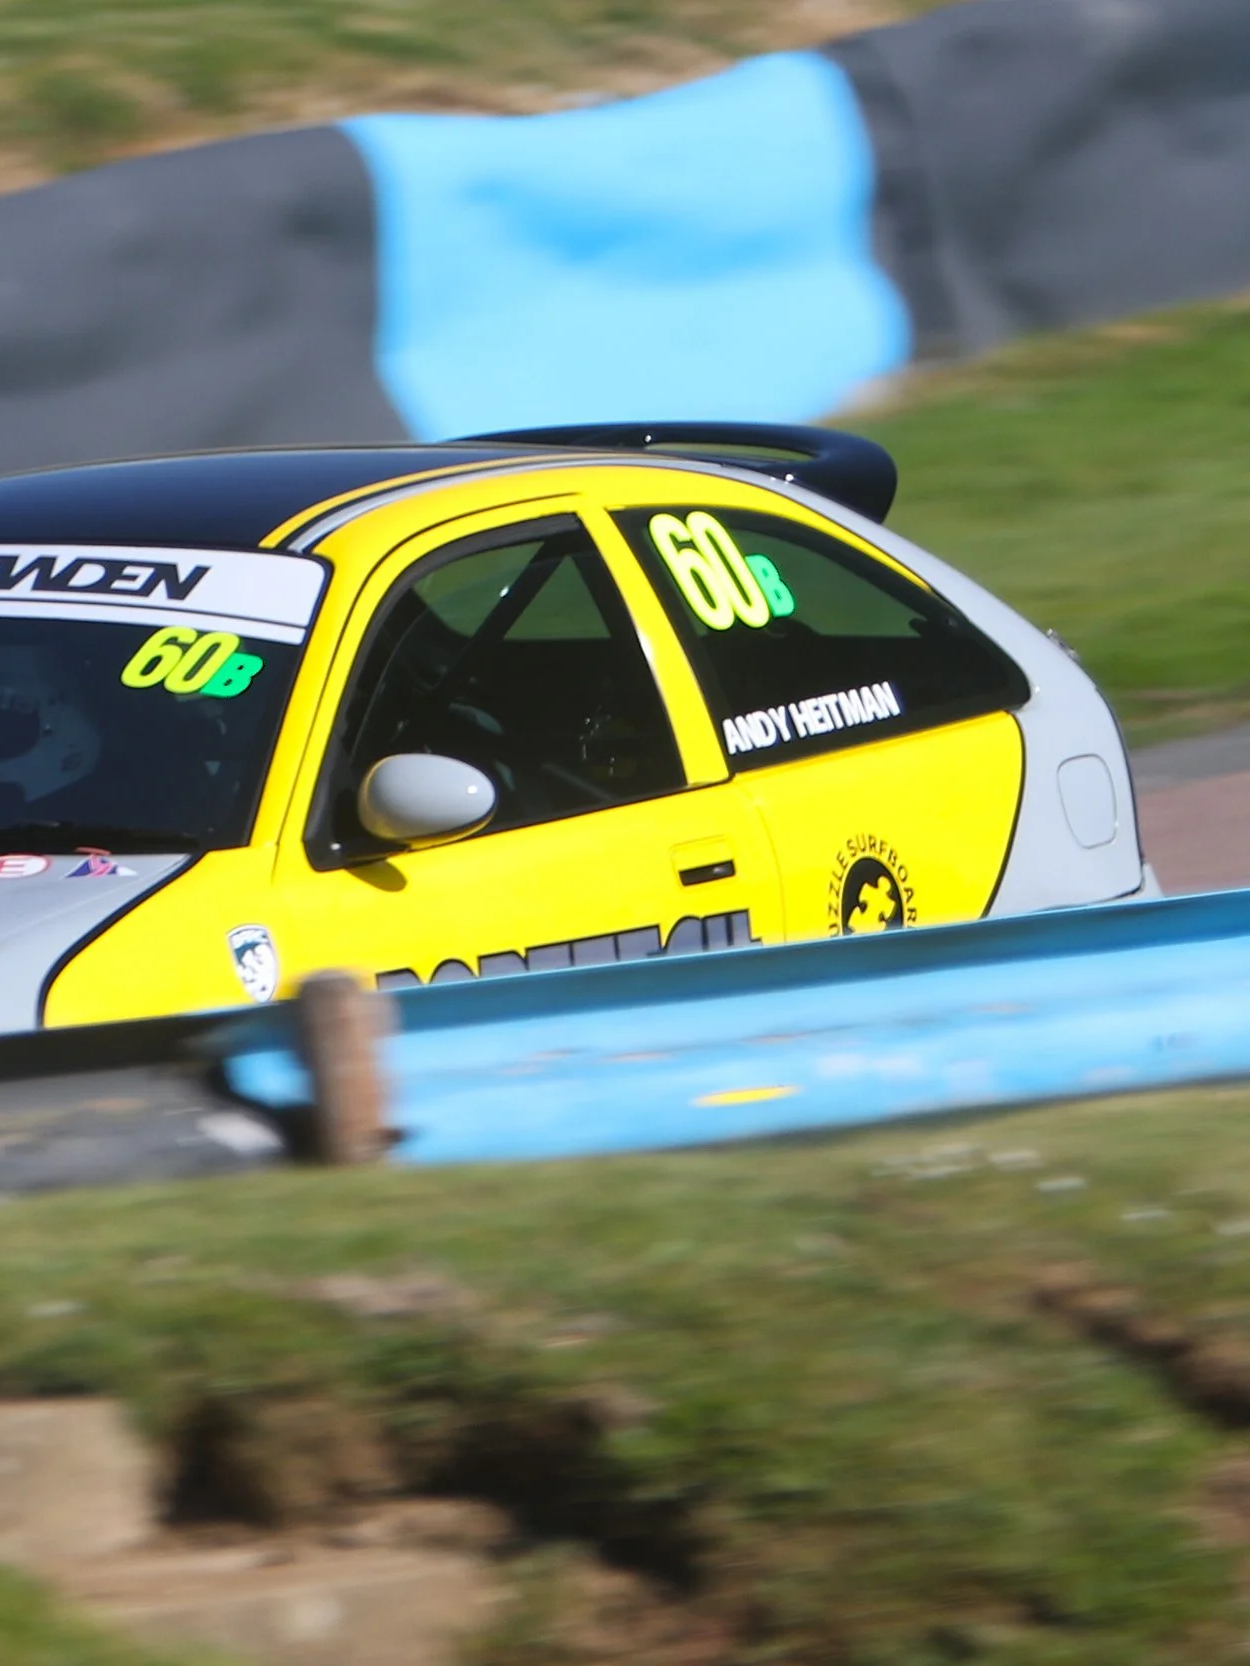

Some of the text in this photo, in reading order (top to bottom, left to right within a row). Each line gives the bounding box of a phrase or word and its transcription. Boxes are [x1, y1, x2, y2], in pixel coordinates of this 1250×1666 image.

[722, 681, 901, 755] ANDY HEITMAN
[828, 832, 918, 936] UZZLE SURFBOAR
